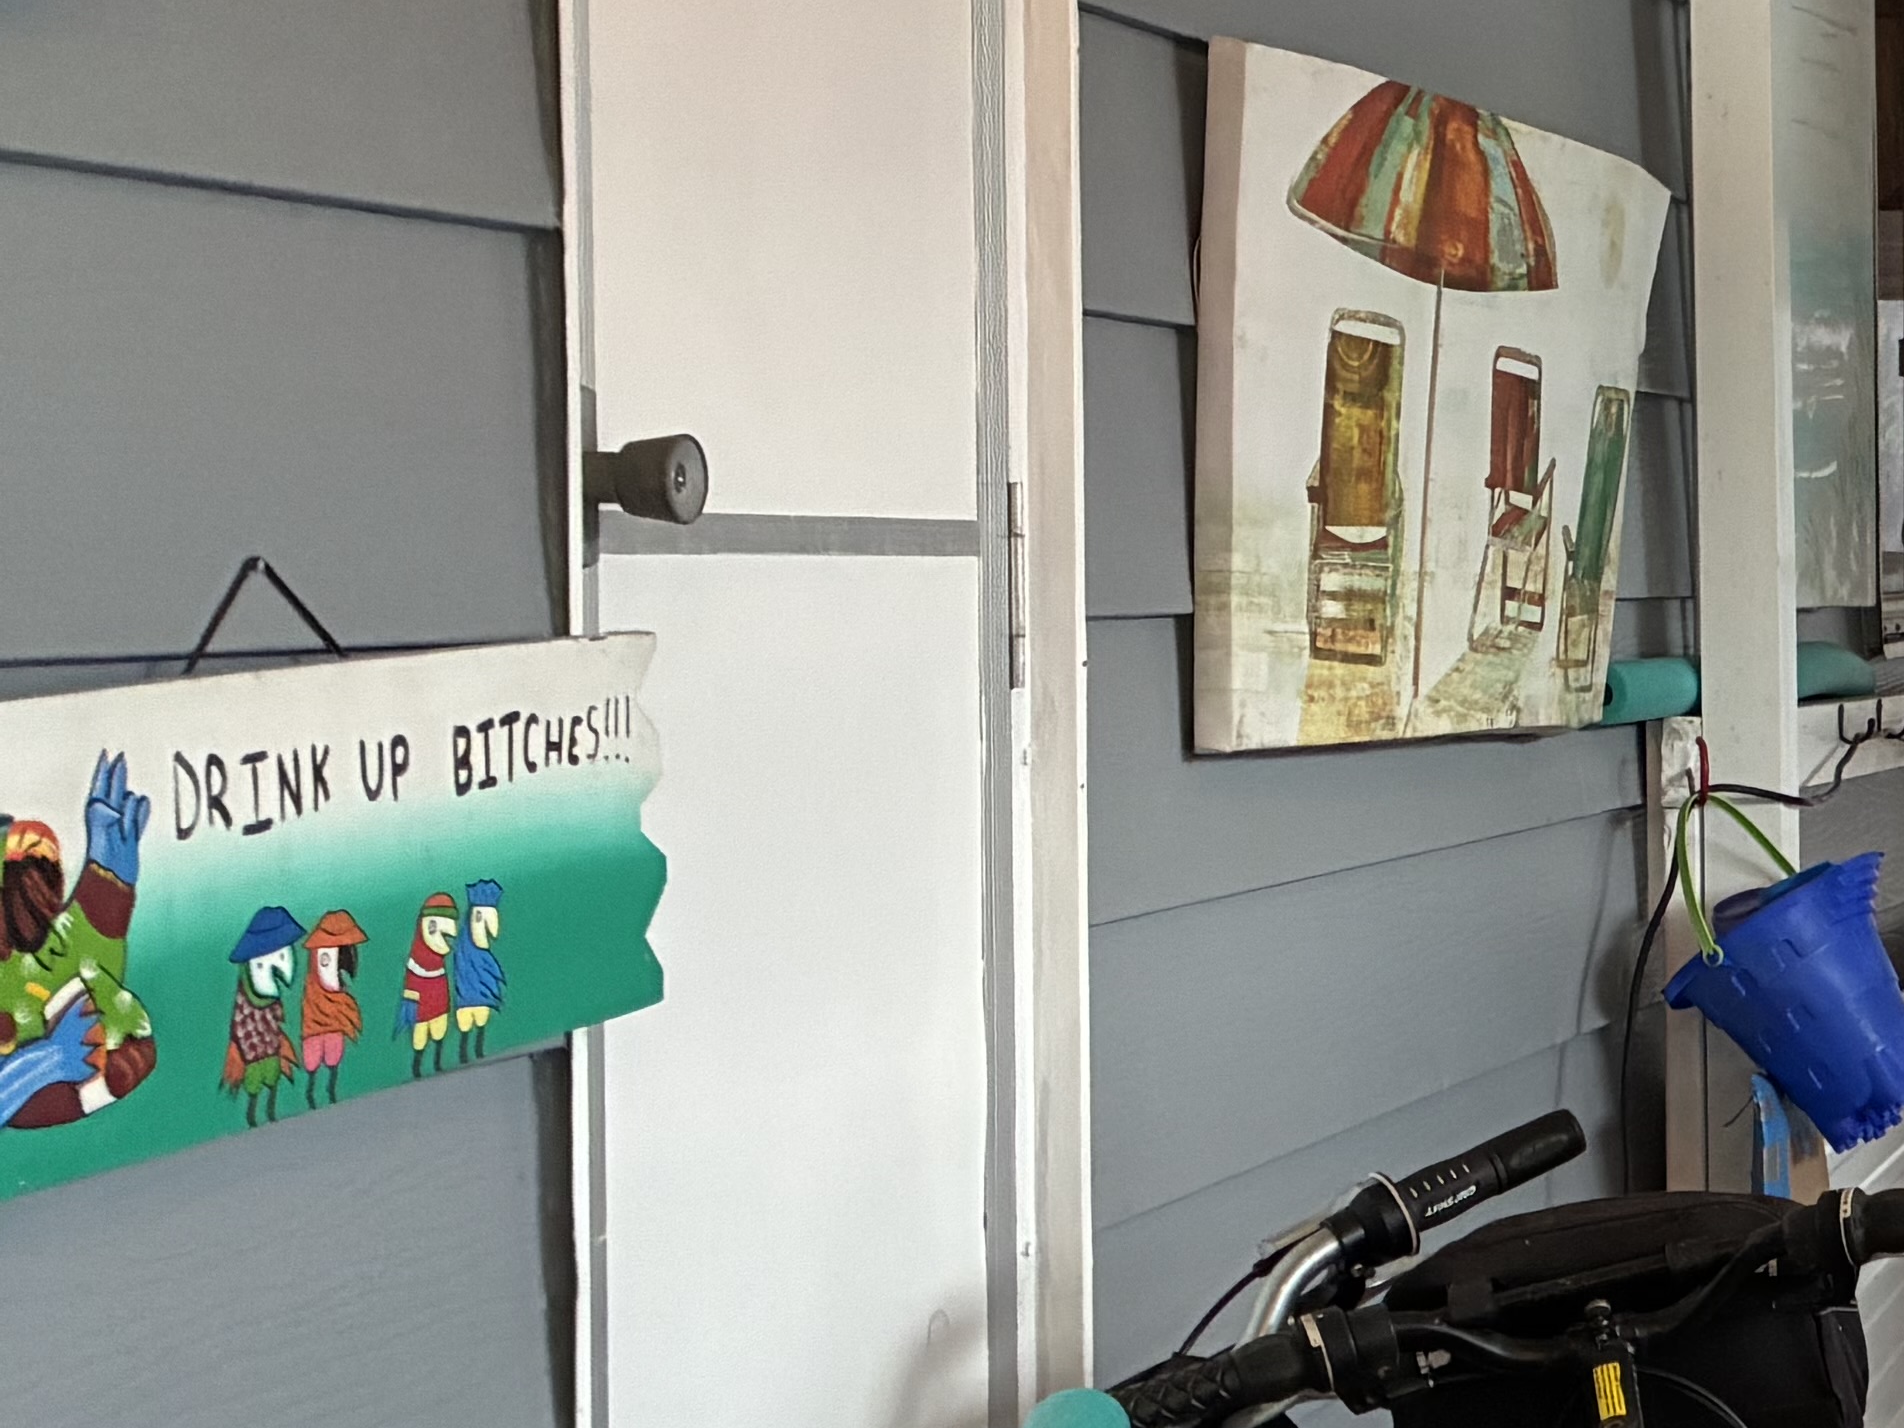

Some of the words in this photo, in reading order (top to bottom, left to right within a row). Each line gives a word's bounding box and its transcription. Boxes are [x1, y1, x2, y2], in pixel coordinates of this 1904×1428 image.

[173, 742, 332, 841] DRINK
[358, 733, 411, 802] UP
[452, 693, 632, 798] BITCHES!!!
